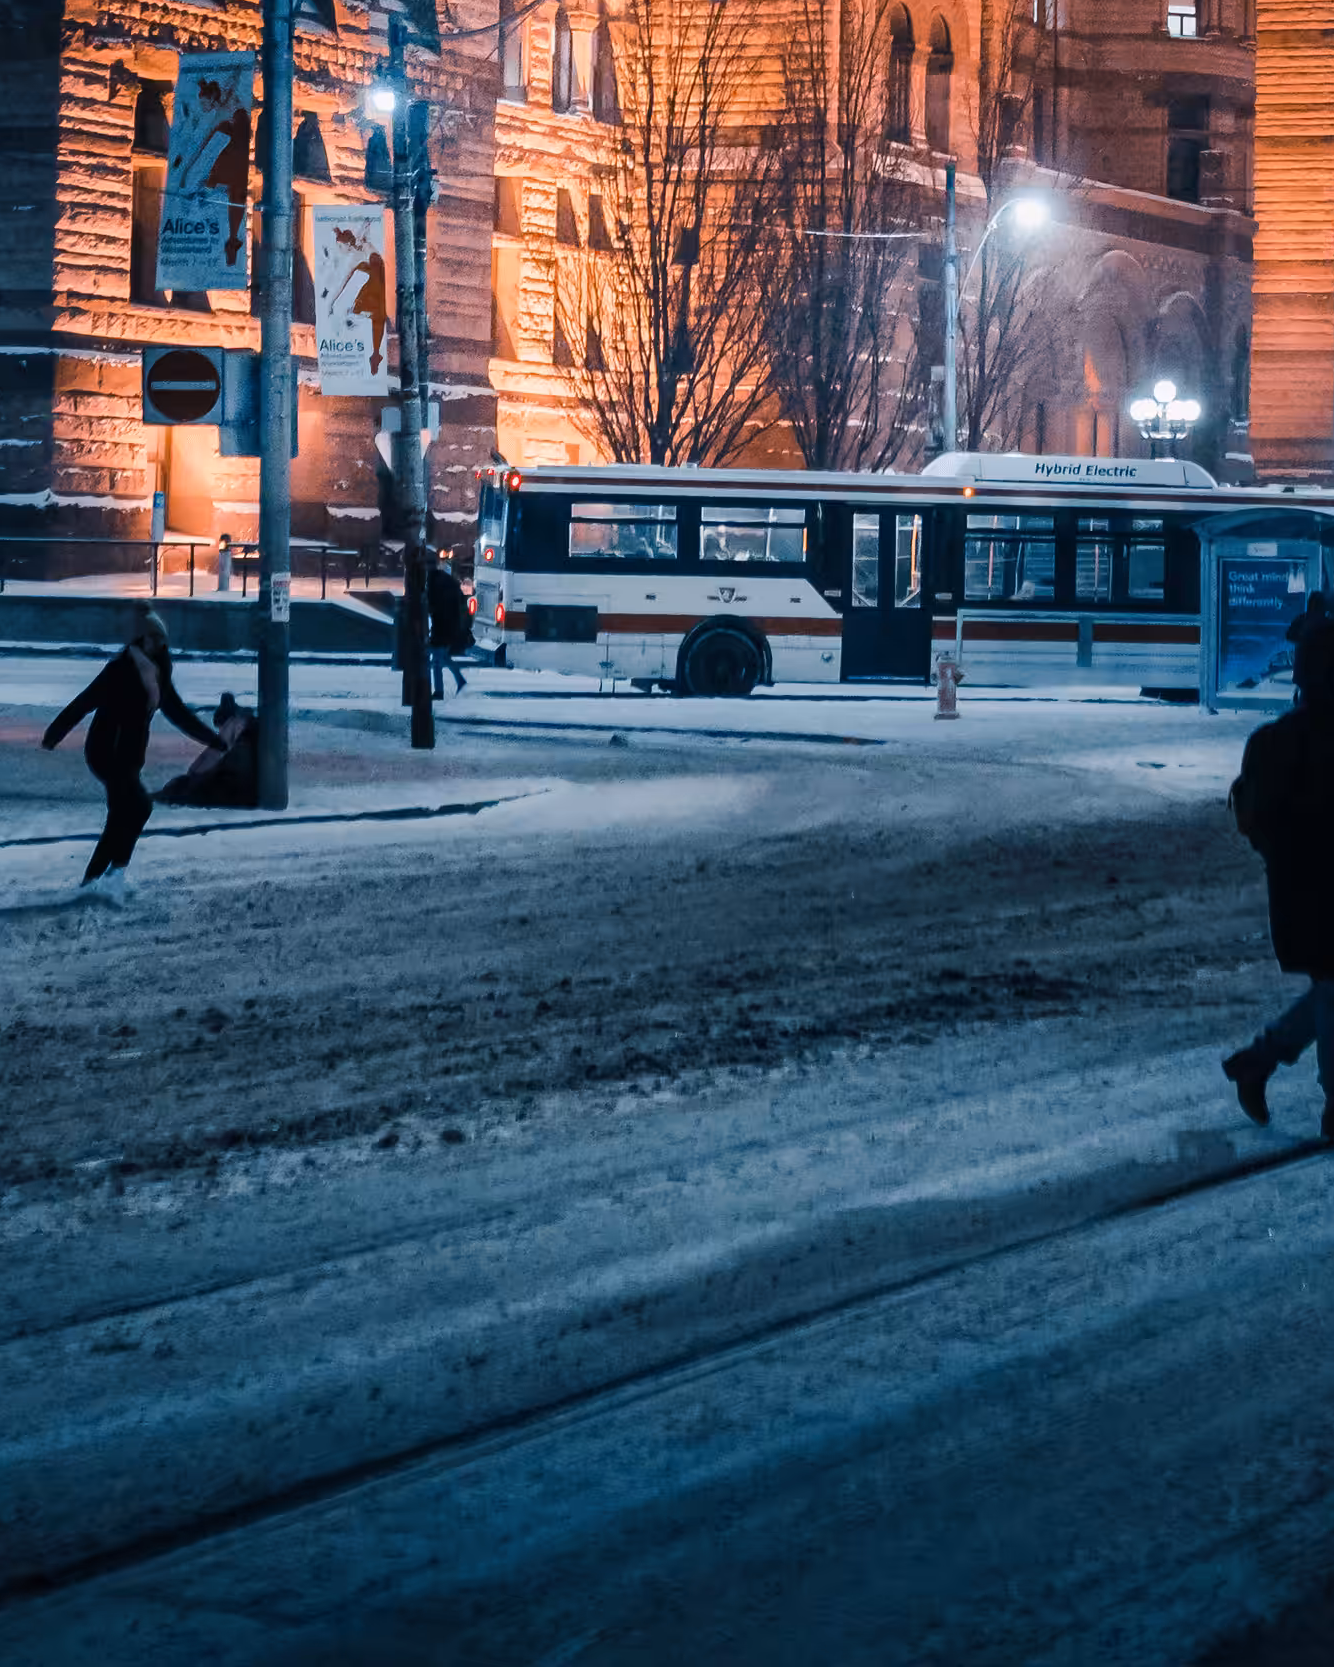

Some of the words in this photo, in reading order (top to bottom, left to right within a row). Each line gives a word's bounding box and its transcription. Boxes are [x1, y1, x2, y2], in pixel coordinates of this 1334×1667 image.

[162, 218, 220, 235] Alice's
[320, 339, 365, 352] Alice's
[1034, 463, 1082, 478] Hybrid
[1085, 465, 1138, 477] Electric
[1228, 570, 1259, 583] Great
[1261, 570, 1289, 583] mind
[1229, 583, 1256, 594] think
